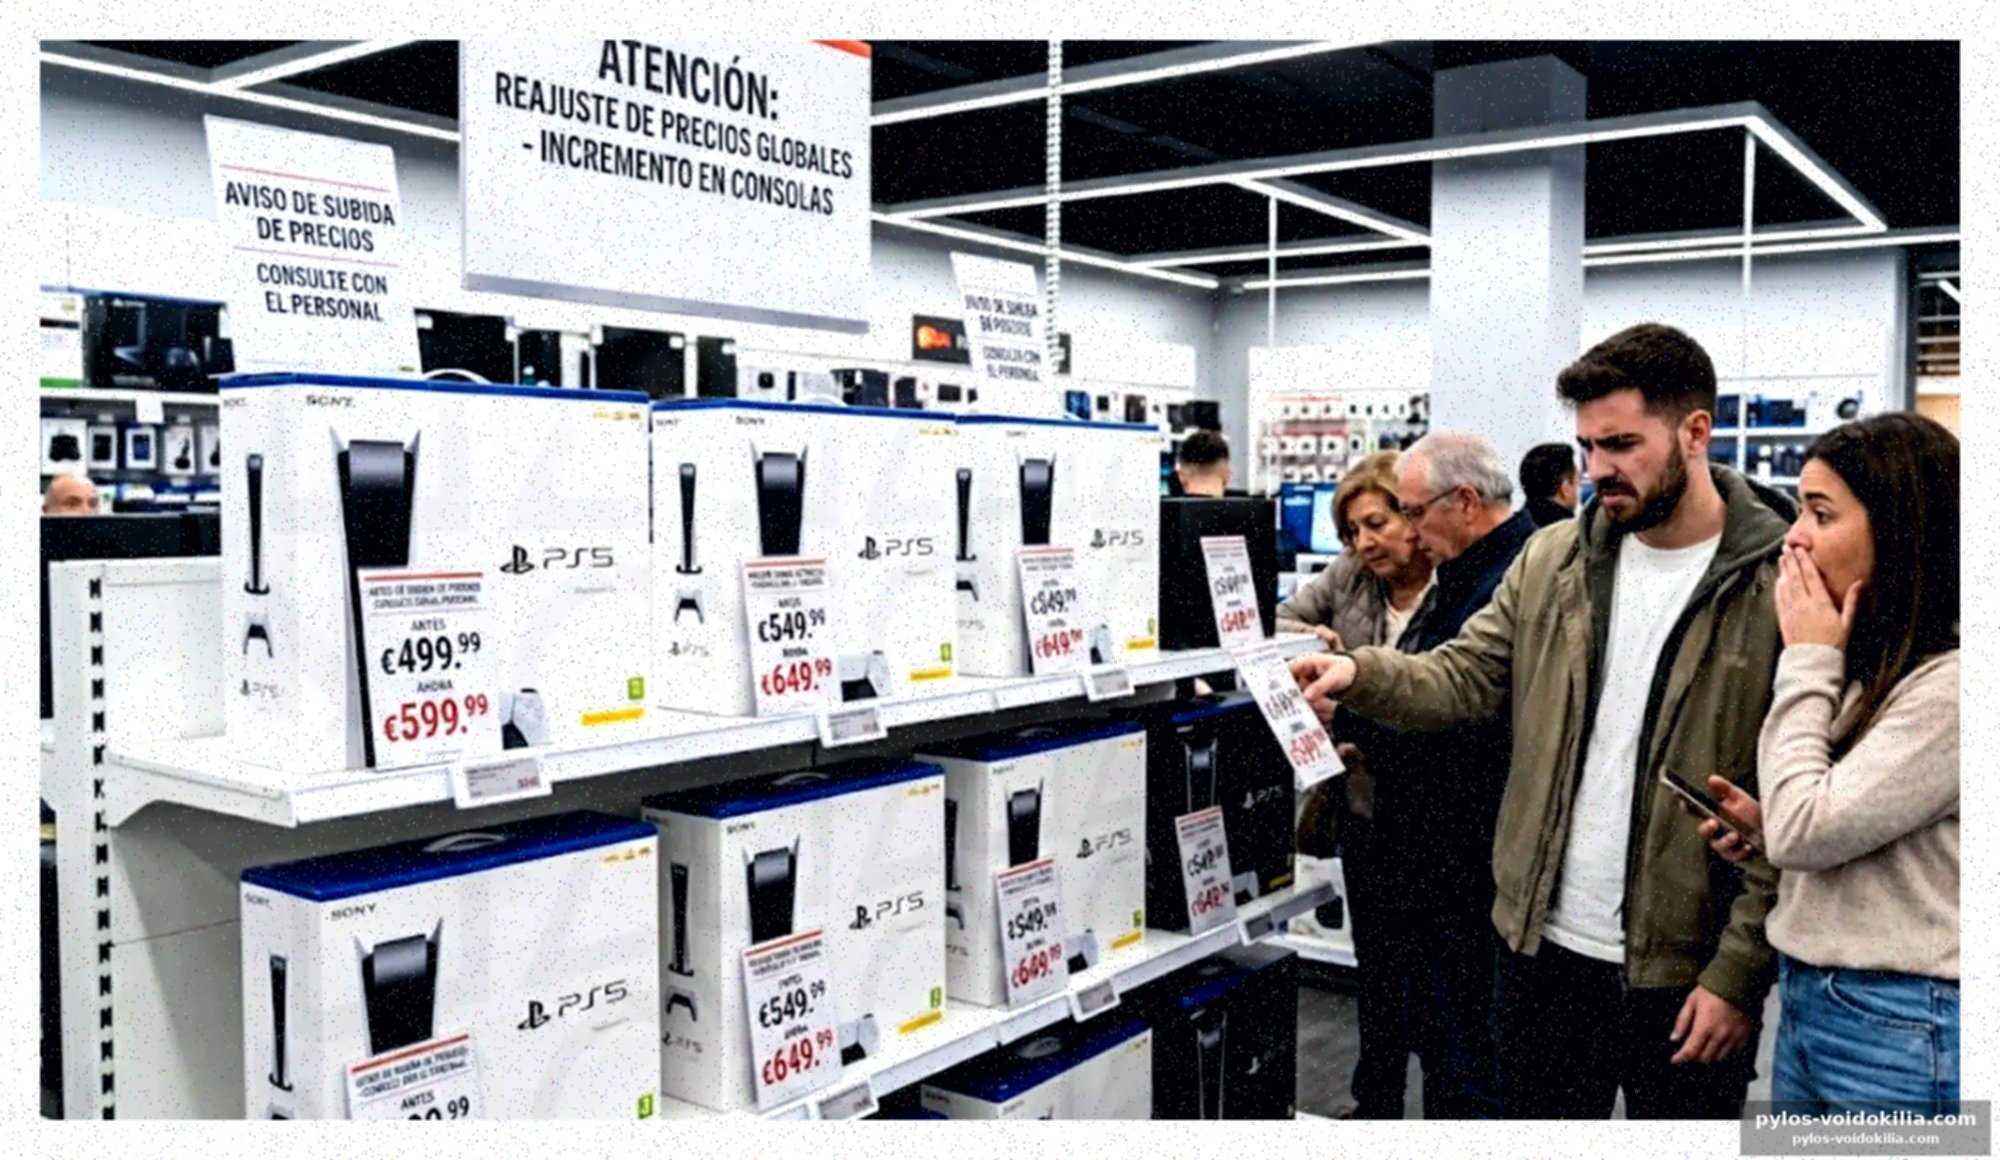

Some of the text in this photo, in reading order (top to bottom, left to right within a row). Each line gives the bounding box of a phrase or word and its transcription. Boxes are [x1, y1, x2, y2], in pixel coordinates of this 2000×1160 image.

[599, 39, 779, 121] ATENCIÓN:
[496, 72, 853, 179] REAJUSTE DE PRECIOS GLOBALES
[541, 130, 692, 189] INCREMENTO
[699, 163, 726, 195] EN
[731, 172, 834, 216] CONSOLAS
[225, 181, 396, 226] AVISO DE SUBIDA
[257, 217, 375, 251] DE PRECIOS
[257, 263, 388, 294] CONSULTE CON
[265, 291, 383, 322] EL PERSONAL
[543, 547, 615, 569] PS5
[886, 538, 934, 556] PS5
[410, 619, 446, 632] ANTES
[758, 608, 825, 643] €549.99
[381, 632, 481, 675] €499.99
[761, 657, 832, 696] €649.99
[384, 693, 489, 742] €599.99
[331, 903, 376, 920] SONY
[876, 891, 924, 920] PS5
[558, 979, 629, 1017] PS5
[762, 1028, 833, 1087] €649.99
